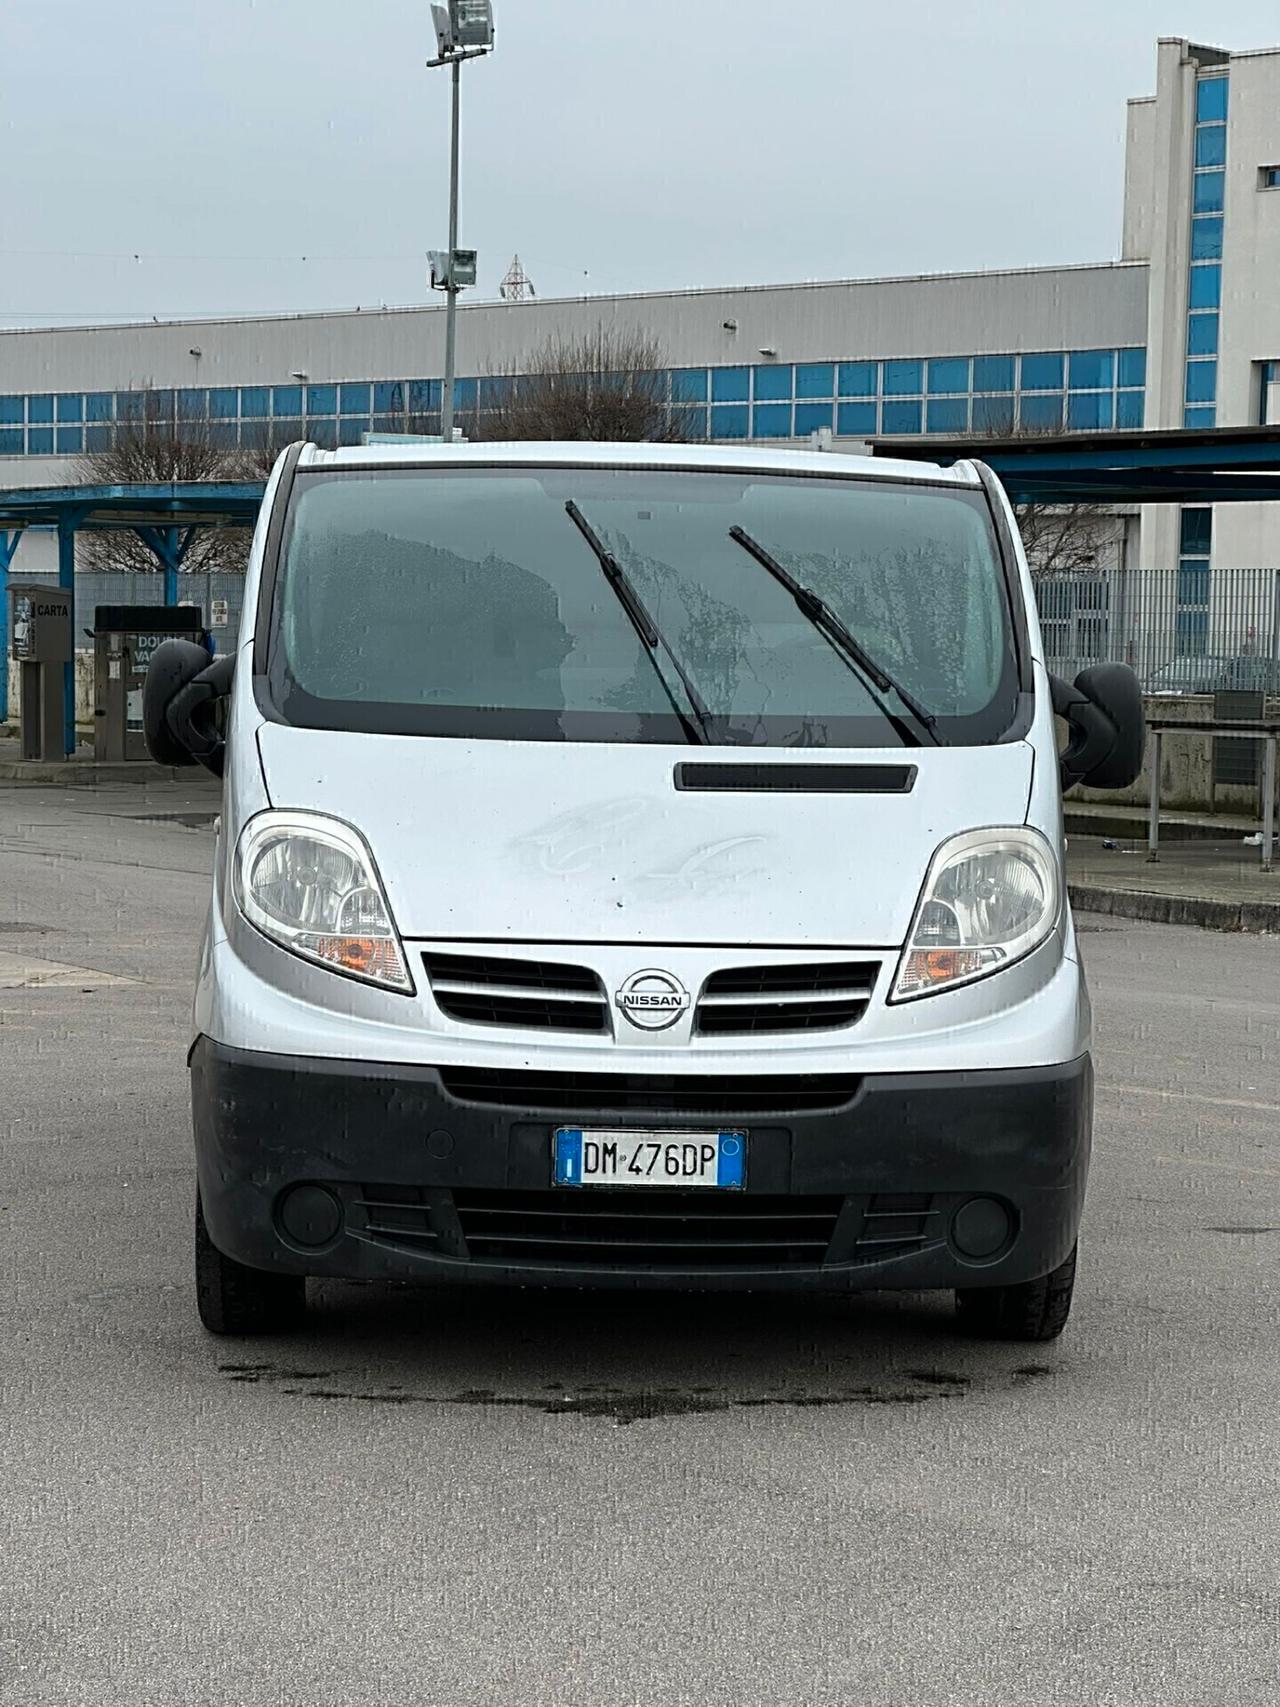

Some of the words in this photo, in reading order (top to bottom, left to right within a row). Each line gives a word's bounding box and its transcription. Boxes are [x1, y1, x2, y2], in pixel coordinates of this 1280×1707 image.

[38, 604, 68, 617] CARTA
[623, 995, 682, 1006] NISSAN
[584, 1142, 618, 1174] DM
[628, 1143, 716, 1176] 476DP
